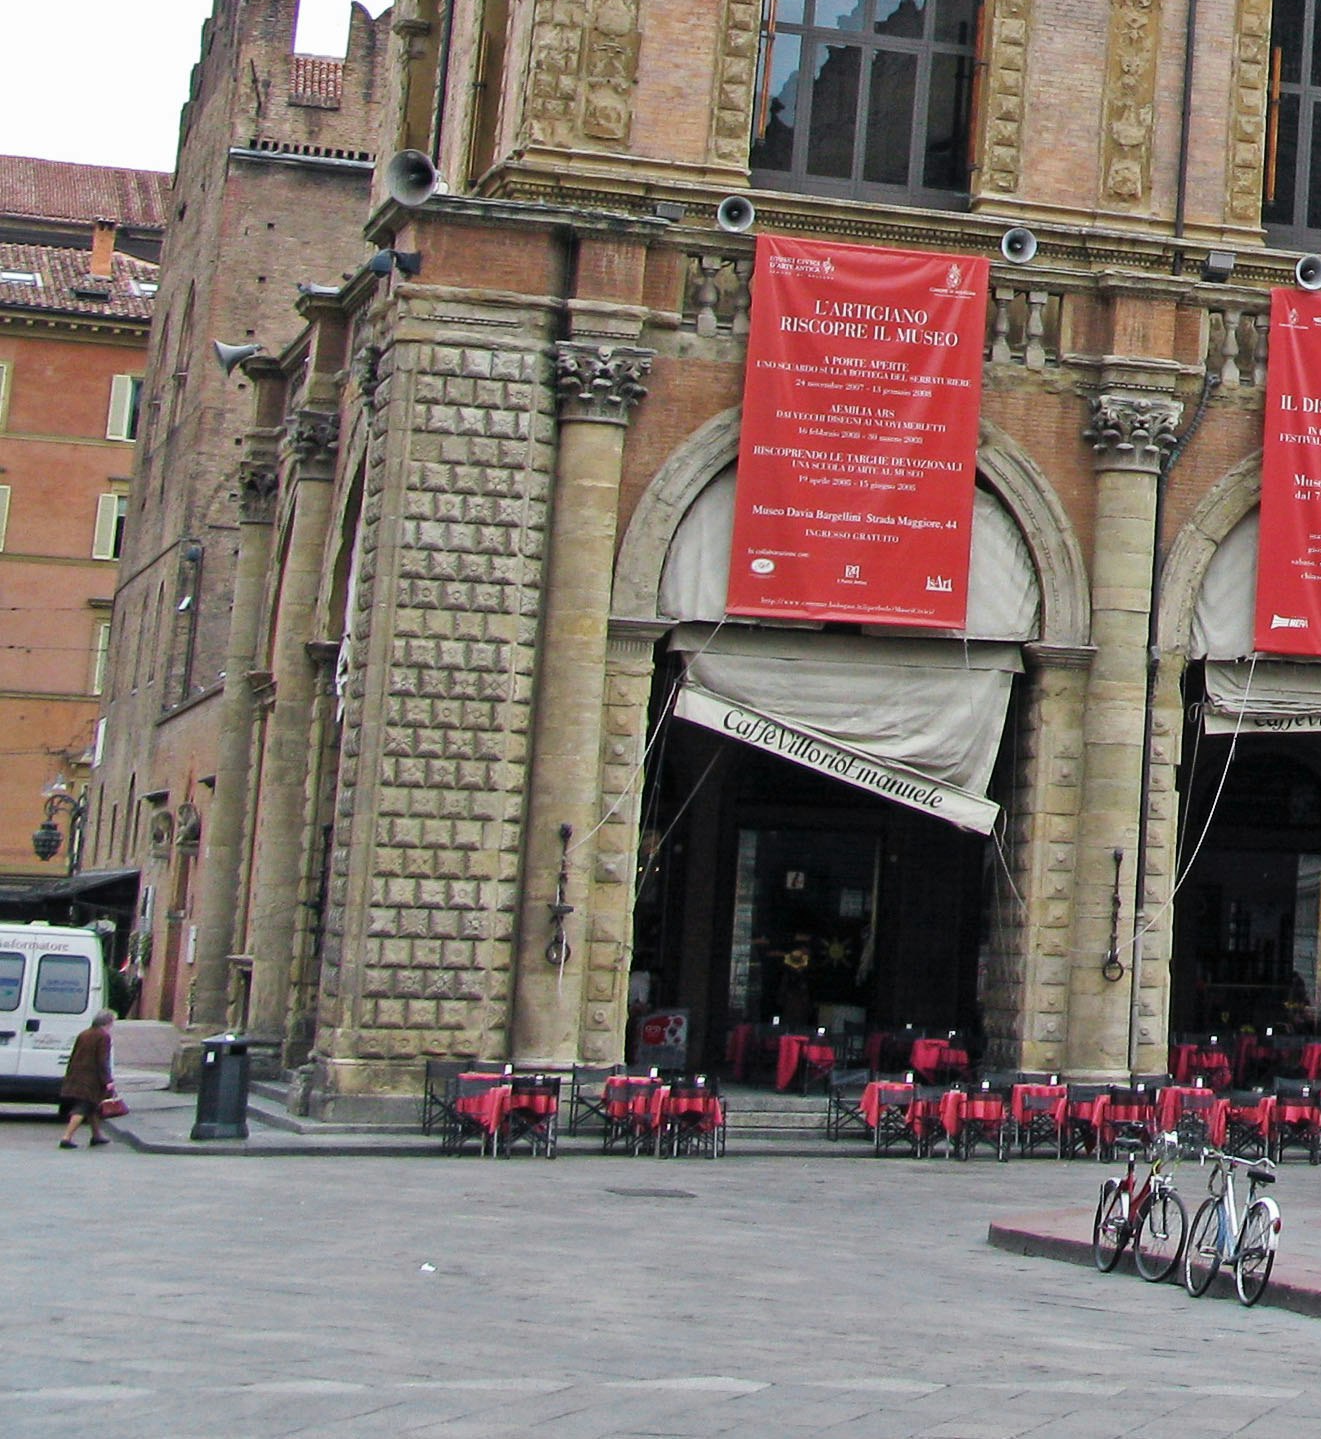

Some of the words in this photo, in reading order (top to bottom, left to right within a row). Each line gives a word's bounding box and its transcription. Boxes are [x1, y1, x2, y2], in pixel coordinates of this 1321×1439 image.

[815, 300, 927, 325] L'ARTIGIANO
[780, 317, 867, 338] RISCOPRE
[874, 325, 890, 340] IL
[896, 327, 958, 346] MUSEO
[1281, 395, 1297, 411] IL
[1280, 434, 1321, 445] FESTIVAL
[753, 446, 827, 461] RISCOPRENDO
[847, 453, 888, 465] TARGHE
[892, 457, 963, 471] DEVOZIONALI
[1295, 491, 1310, 501] dal
[1315, 492, 1320, 502] 7
[752, 505, 784, 516] Museo
[787, 508, 814, 518] Davia
[817, 510, 860, 524] Bargellini
[866, 513, 896, 524] Strada
[898, 516, 943, 530] Maggiore,
[946, 519, 957, 529] 44
[805, 529, 850, 539] INGRESSO
[853, 532, 899, 543] GRATUITO
[843, 754, 944, 809] Emanuele
